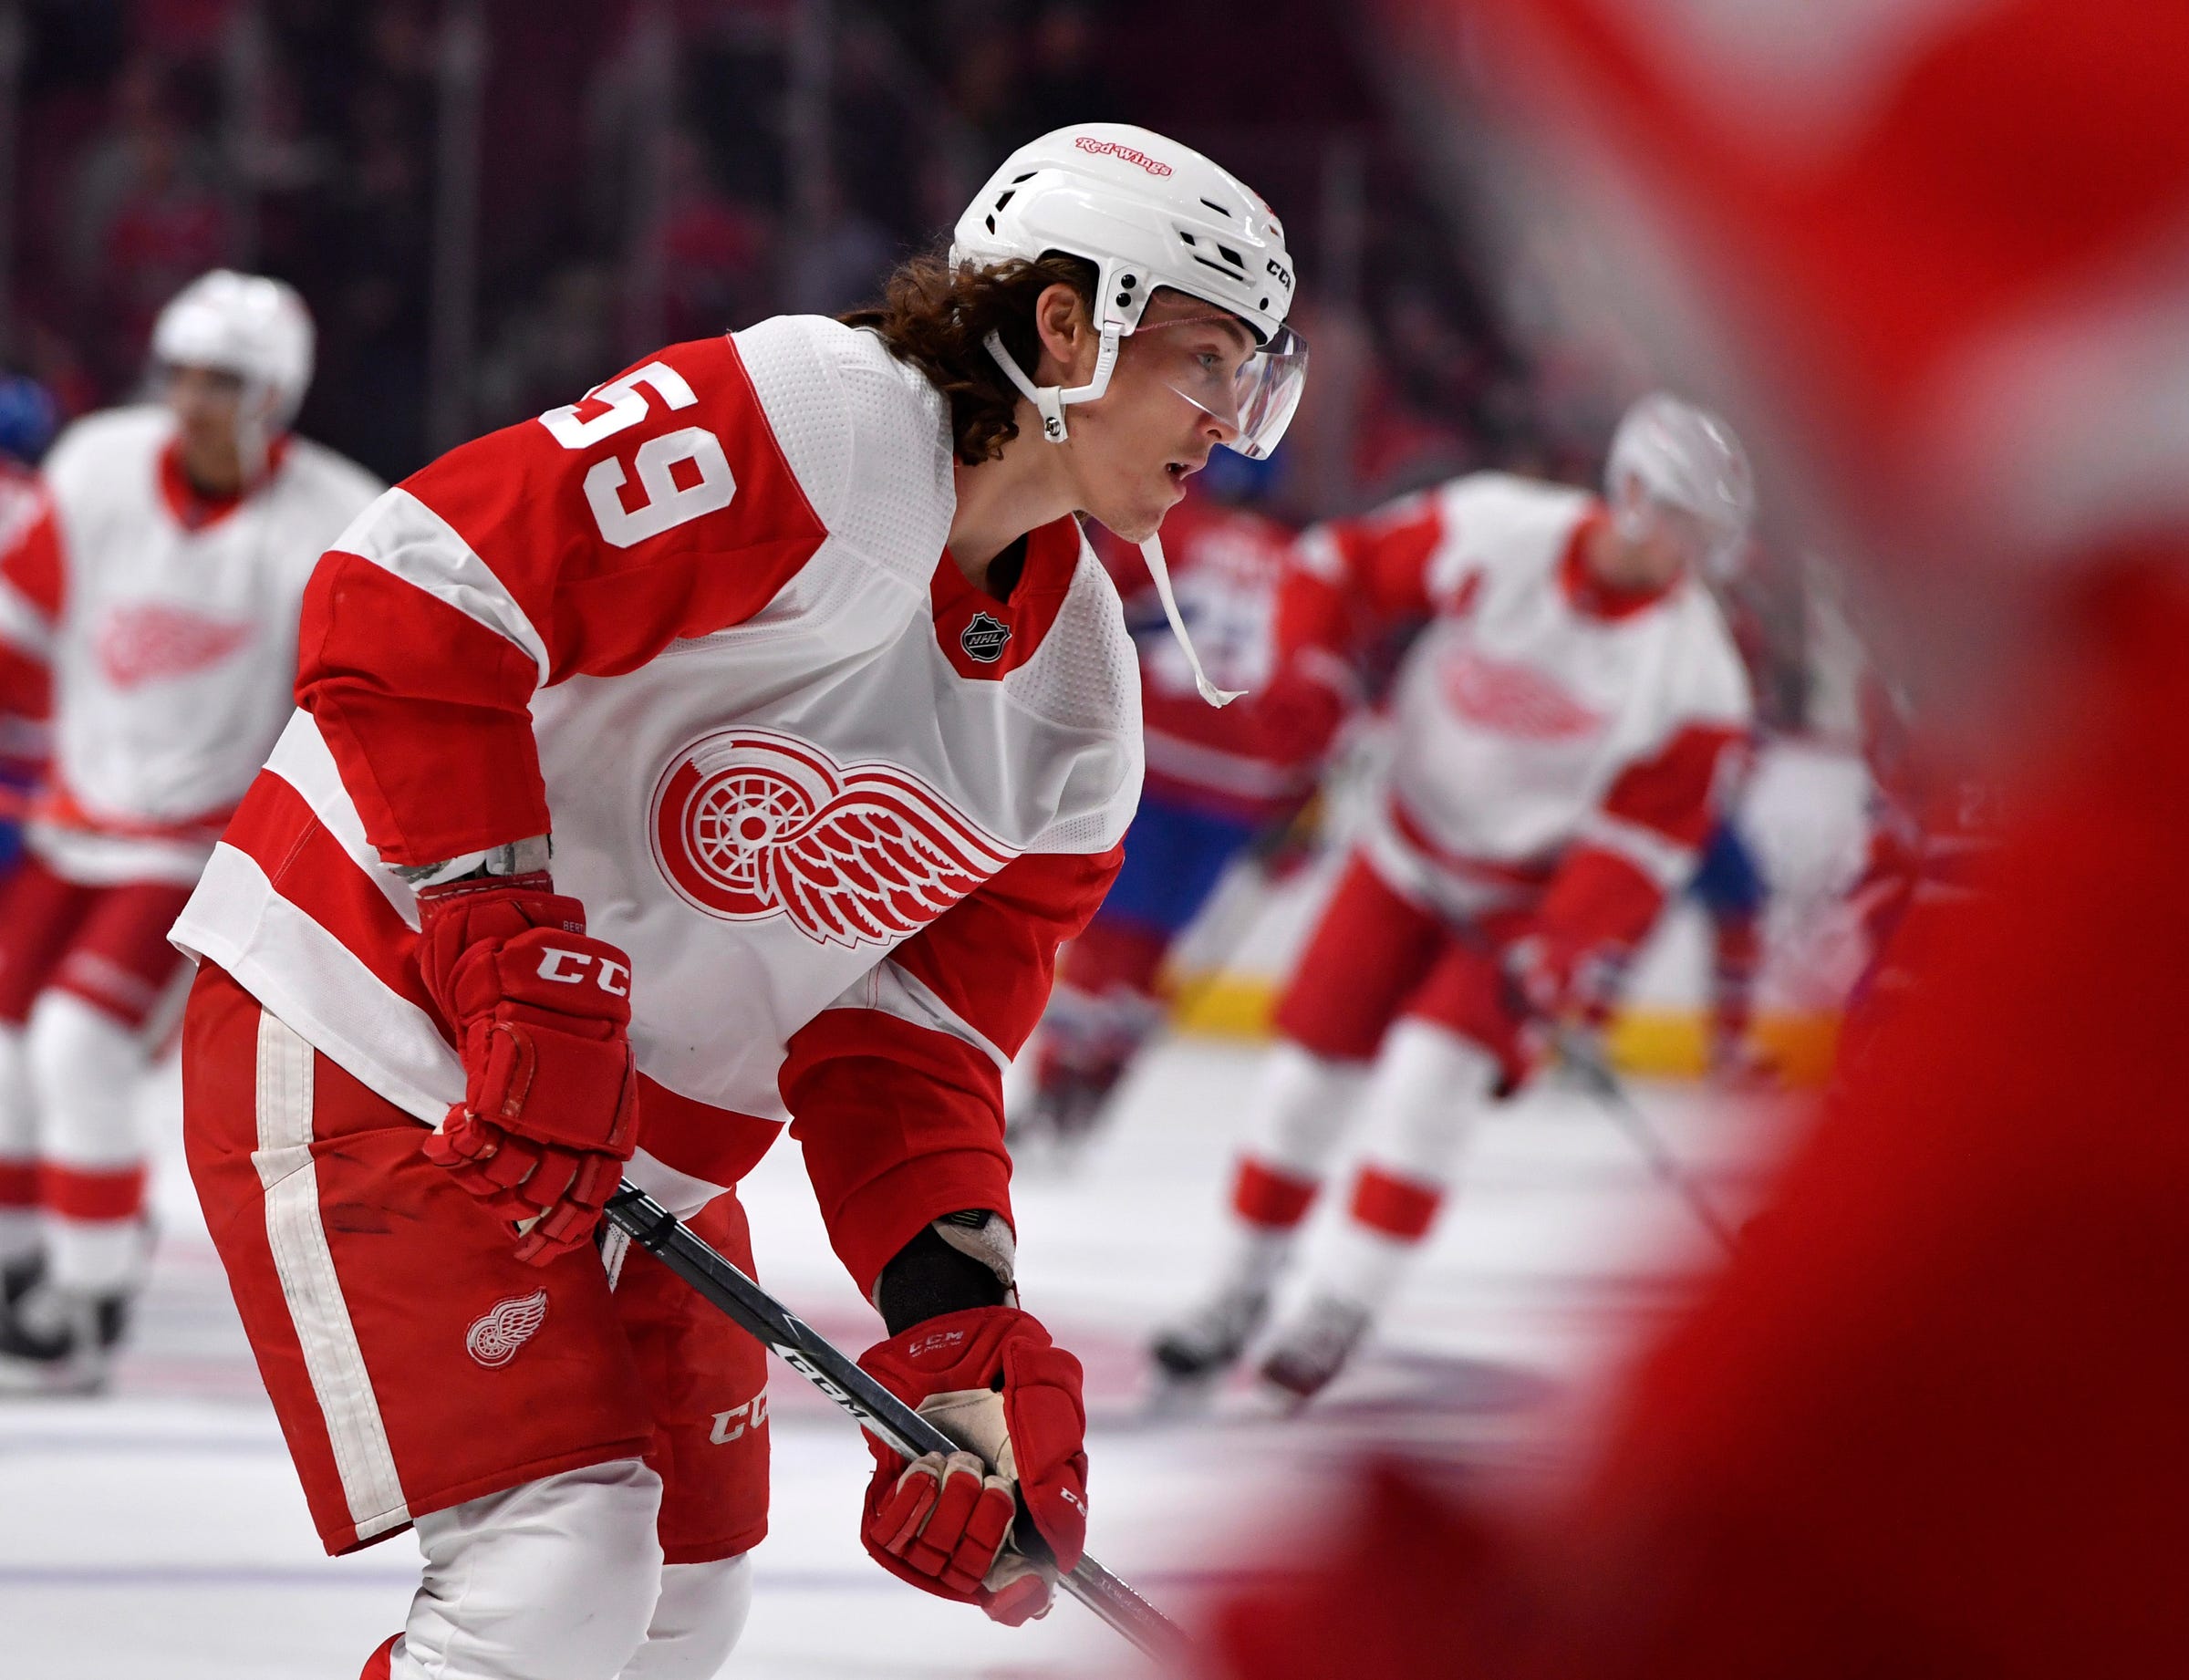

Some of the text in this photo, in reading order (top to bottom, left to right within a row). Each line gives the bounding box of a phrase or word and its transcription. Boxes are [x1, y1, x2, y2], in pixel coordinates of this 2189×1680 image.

[1075, 137, 1173, 177] Red Wings
[537, 360, 737, 548] 59
[969, 633, 1000, 646] NHL
[784, 1354, 870, 1417] CCM
